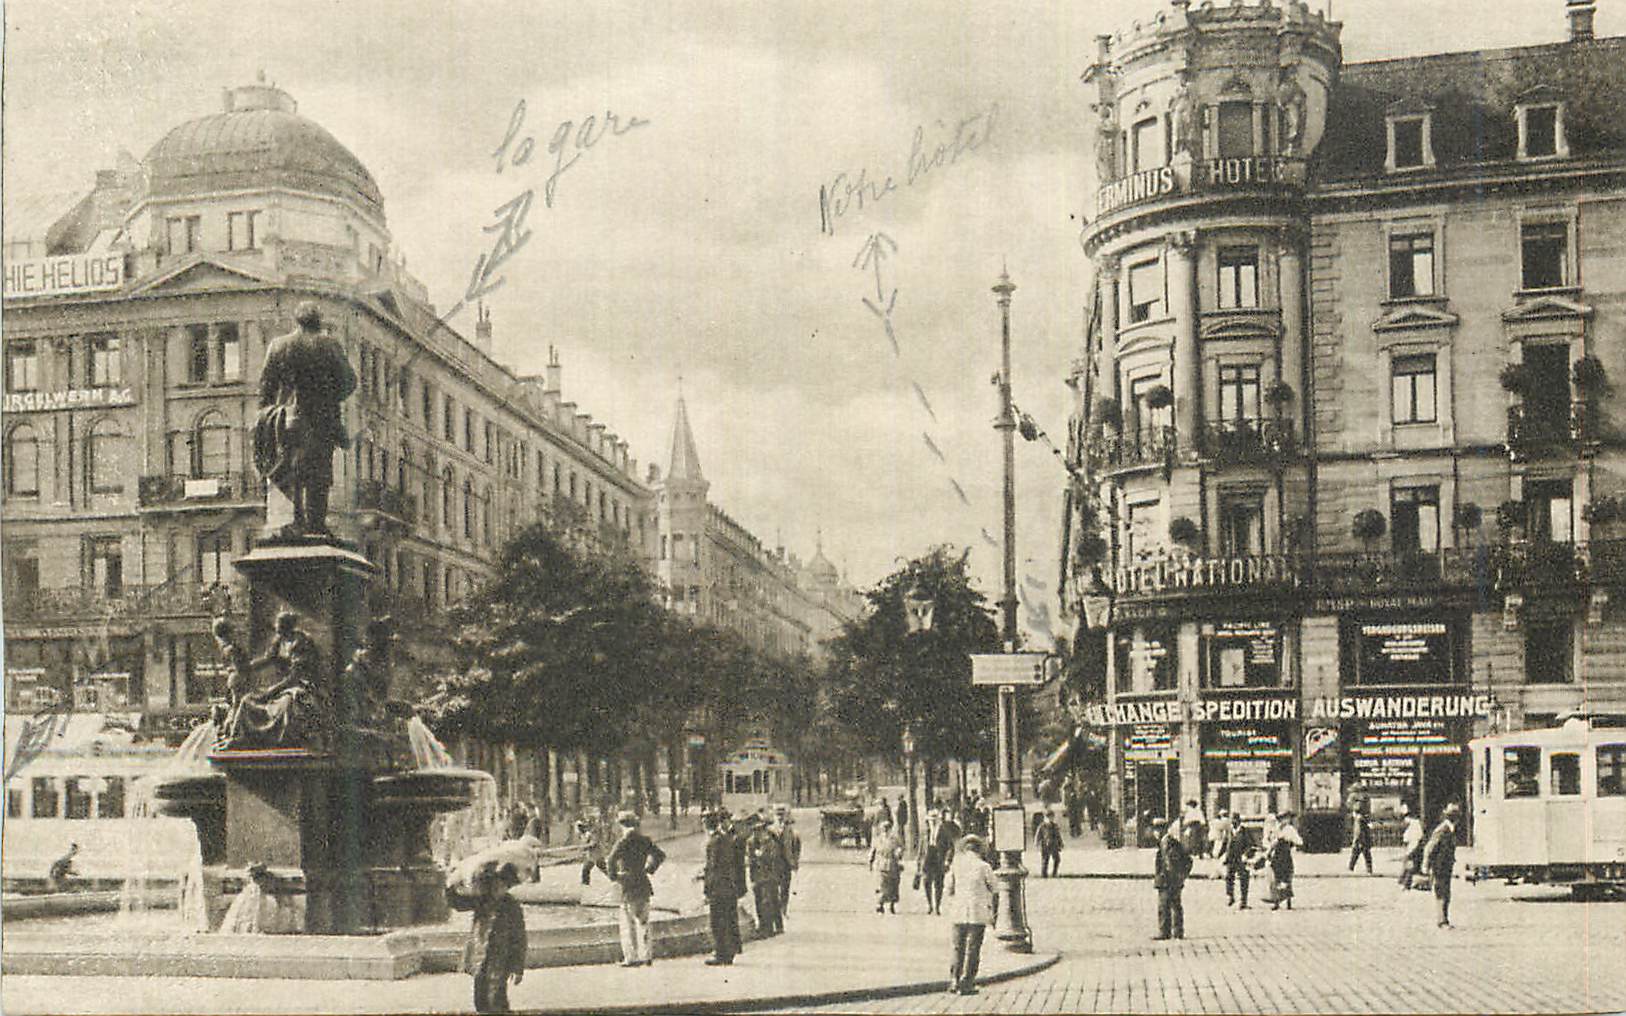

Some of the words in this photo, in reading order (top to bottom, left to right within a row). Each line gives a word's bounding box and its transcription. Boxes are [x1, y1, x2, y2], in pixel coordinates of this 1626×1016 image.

[545, 109, 651, 208] gare
[1098, 167, 1174, 210] ERMINUS
[42, 257, 119, 289] HELIOS
[1191, 698, 1297, 721] SPEDITION
[1312, 694, 1490, 719] AUSWANDERUNG
